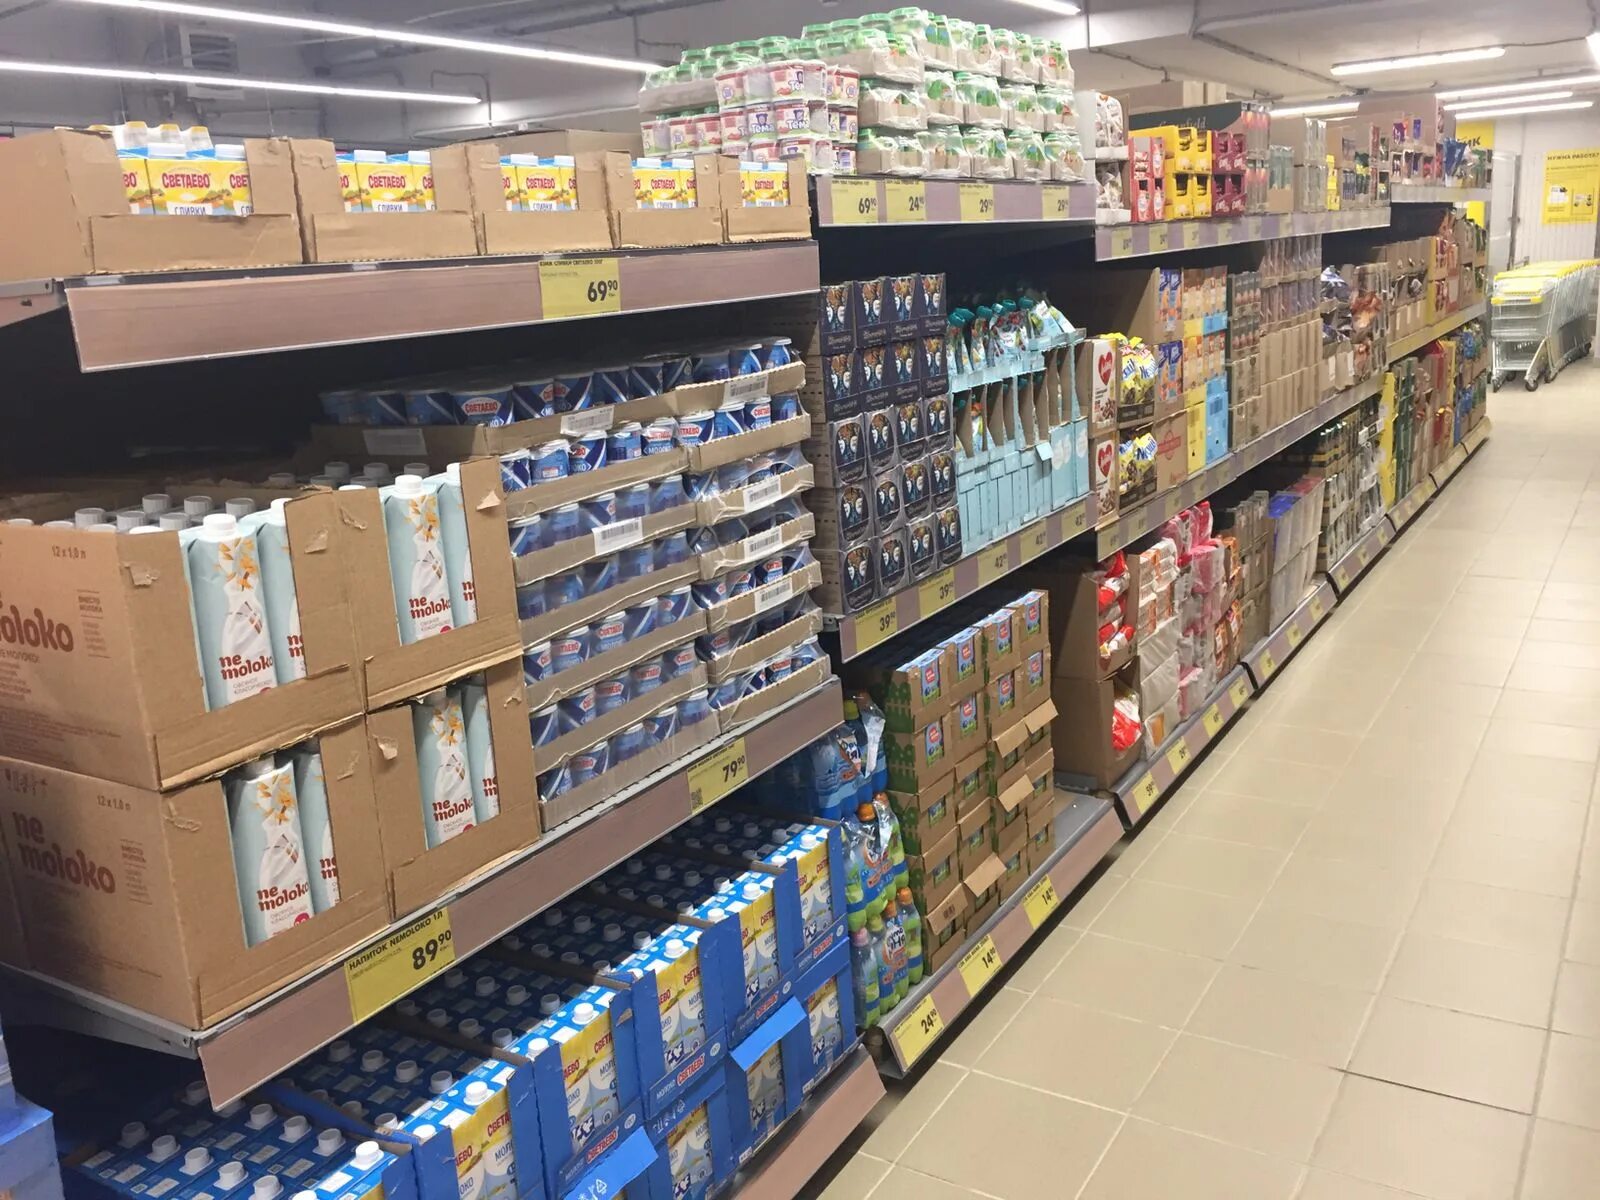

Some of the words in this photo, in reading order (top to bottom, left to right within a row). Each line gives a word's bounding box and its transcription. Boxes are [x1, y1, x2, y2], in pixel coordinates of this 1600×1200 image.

[162, 173, 211, 188] СВЕТАЕВО
[368, 175, 406, 189] СВЕТАЕВО
[526, 177, 556, 189] СВЕТАЕВО
[858, 198, 871, 214] 69
[909, 195, 920, 212] 24
[587, 280, 608, 303] 69
[607, 279, 618, 291] 90
[464, 402, 498, 414] СВЕТАЕВО
[939, 584, 950, 600] 39
[409, 596, 428, 609] ne
[0, 604, 75, 653] oloko
[879, 614, 891, 632] 39
[219, 654, 242, 668] ne
[221, 655, 274, 680] moloko
[722, 760, 738, 783] 79
[432, 799, 451, 811] ne
[12, 811, 45, 844] ne
[17, 842, 116, 894] moloko
[257, 885, 279, 900] ne
[258, 881, 310, 912] moloko
[1041, 890, 1052, 905] 14
[348, 943, 388, 971] НАПИТОК
[389, 917, 432, 948] NEMOLOKO
[433, 910, 443, 921] 1Л
[412, 938, 438, 970] 89
[437, 929, 452, 946] 90
[982, 951, 994, 969] 14
[920, 1014, 934, 1035] 24
[677, 1053, 705, 1086] СВЕТАЕВО
[586, 1128, 618, 1164] СВЕТАЕВО
